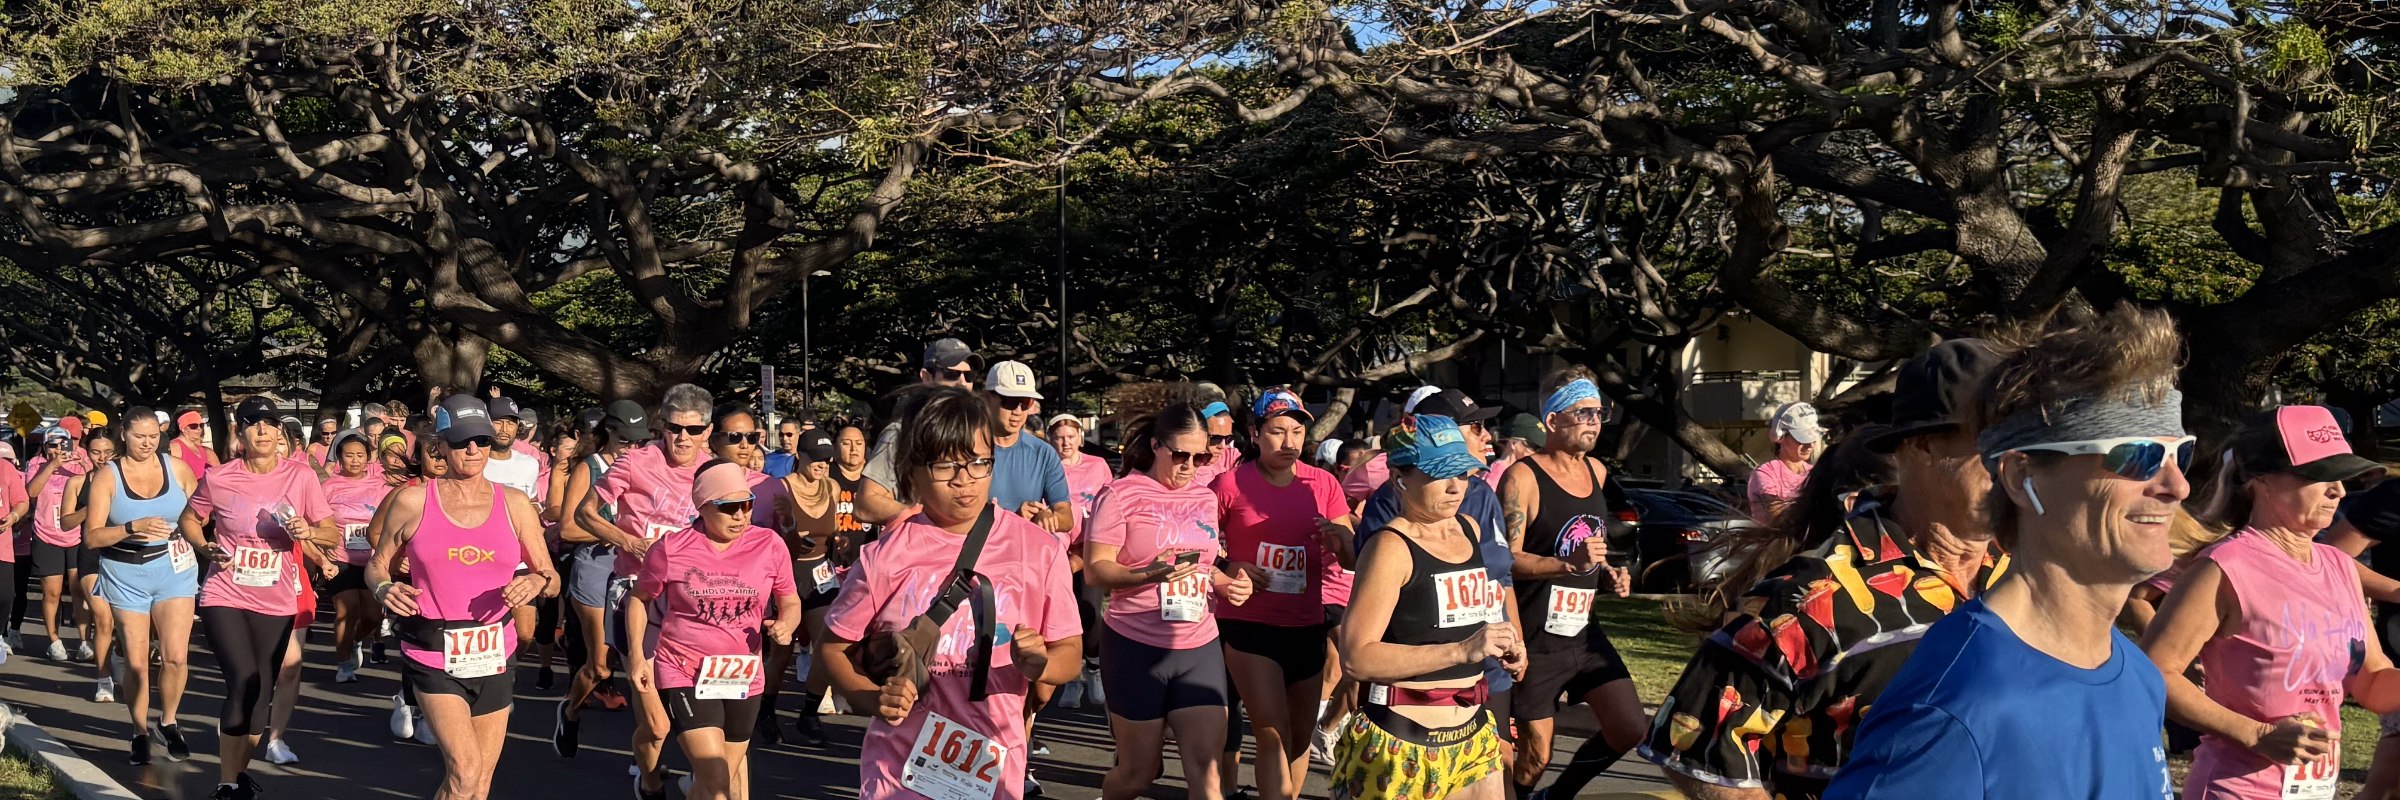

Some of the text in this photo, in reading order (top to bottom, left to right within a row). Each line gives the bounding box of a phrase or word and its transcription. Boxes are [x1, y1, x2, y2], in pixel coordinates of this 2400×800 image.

[239, 548, 281, 569] 1687
[447, 545, 496, 566] FOX
[1261, 545, 1305, 571] 1628
[1166, 573, 1208, 599] 1634
[1443, 571, 1486, 611] 1627
[450, 626, 500, 656] 1707
[705, 656, 757, 680] 1724
[921, 721, 1001, 784] 1612
